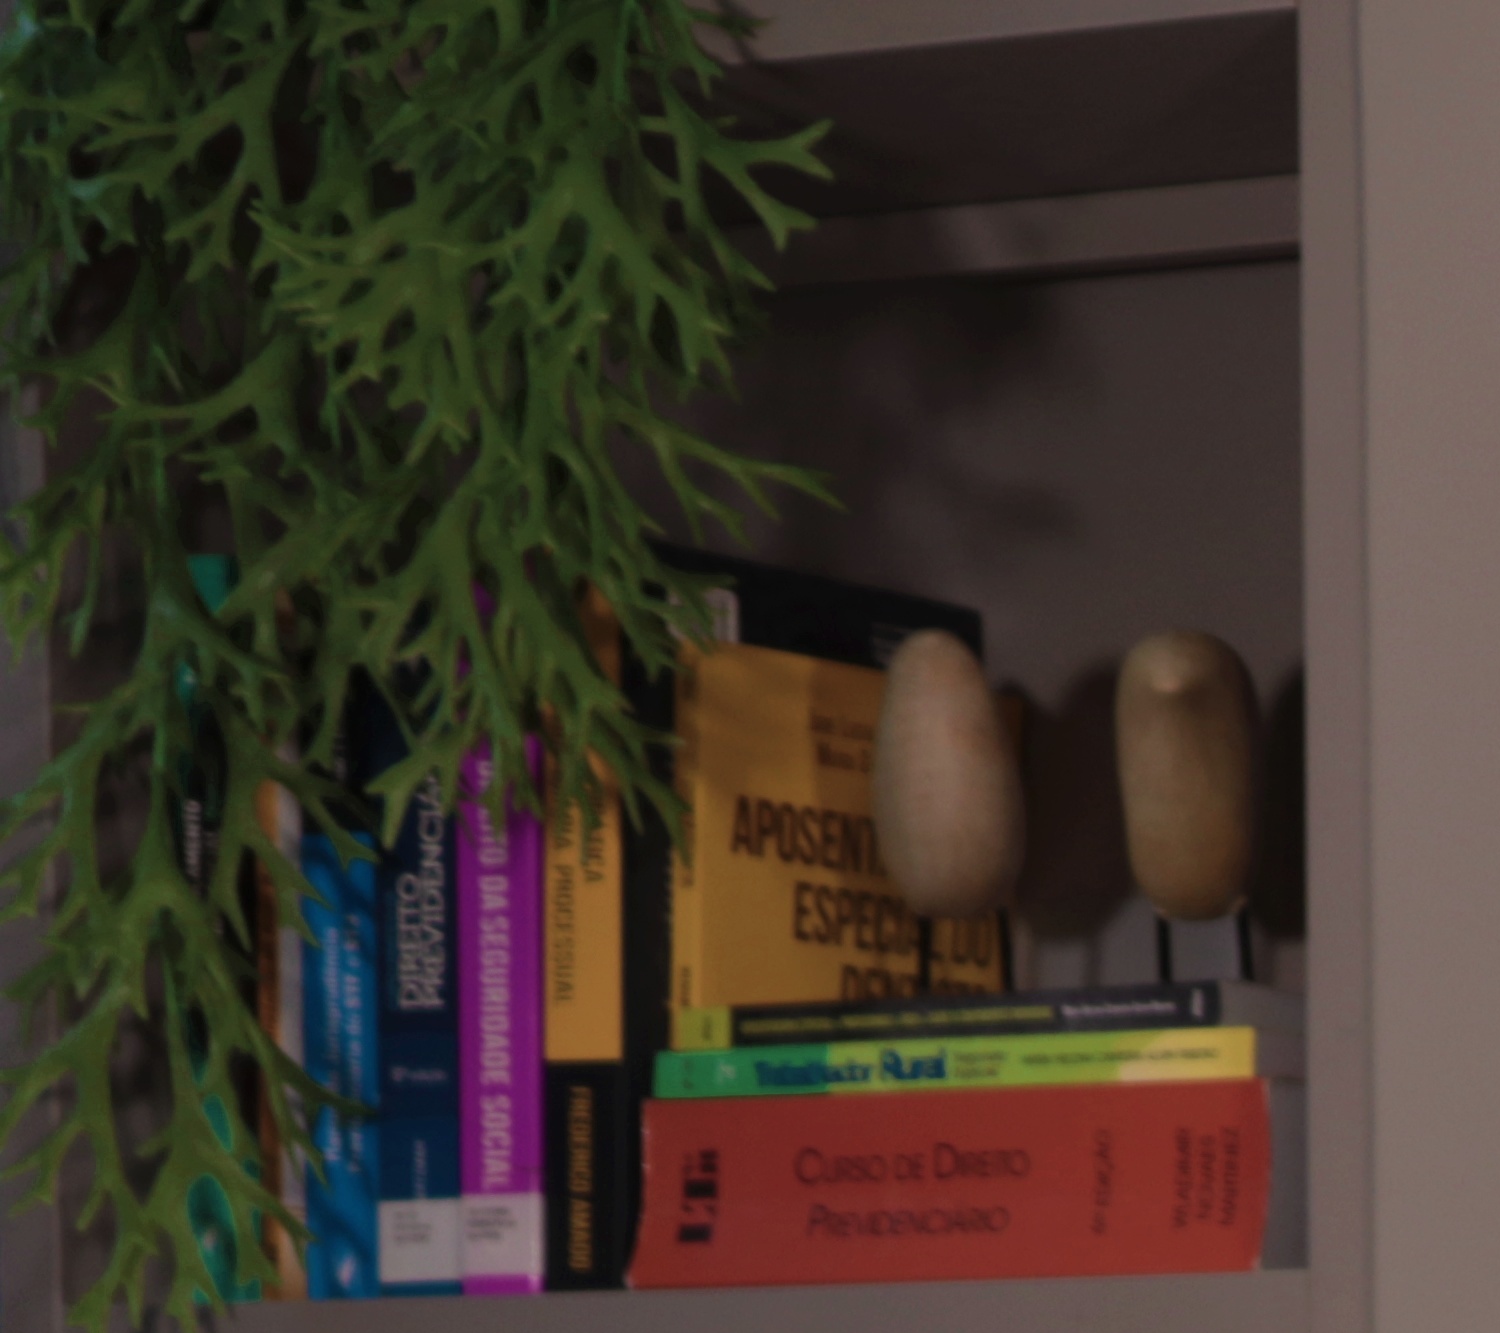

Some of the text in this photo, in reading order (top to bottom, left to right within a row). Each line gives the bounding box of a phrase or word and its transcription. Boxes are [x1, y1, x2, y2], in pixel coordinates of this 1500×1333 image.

[731, 794, 888, 878] APOSENT
[398, 872, 422, 1011] DIREITO
[479, 874, 509, 911] DA
[478, 915, 511, 1087] SEGURIDADE
[480, 1093, 512, 1192] SOCIAL
[570, 1086, 593, 1273] FREDERICO AMADO
[793, 1142, 1031, 1184] CURSO DE DIREITO
